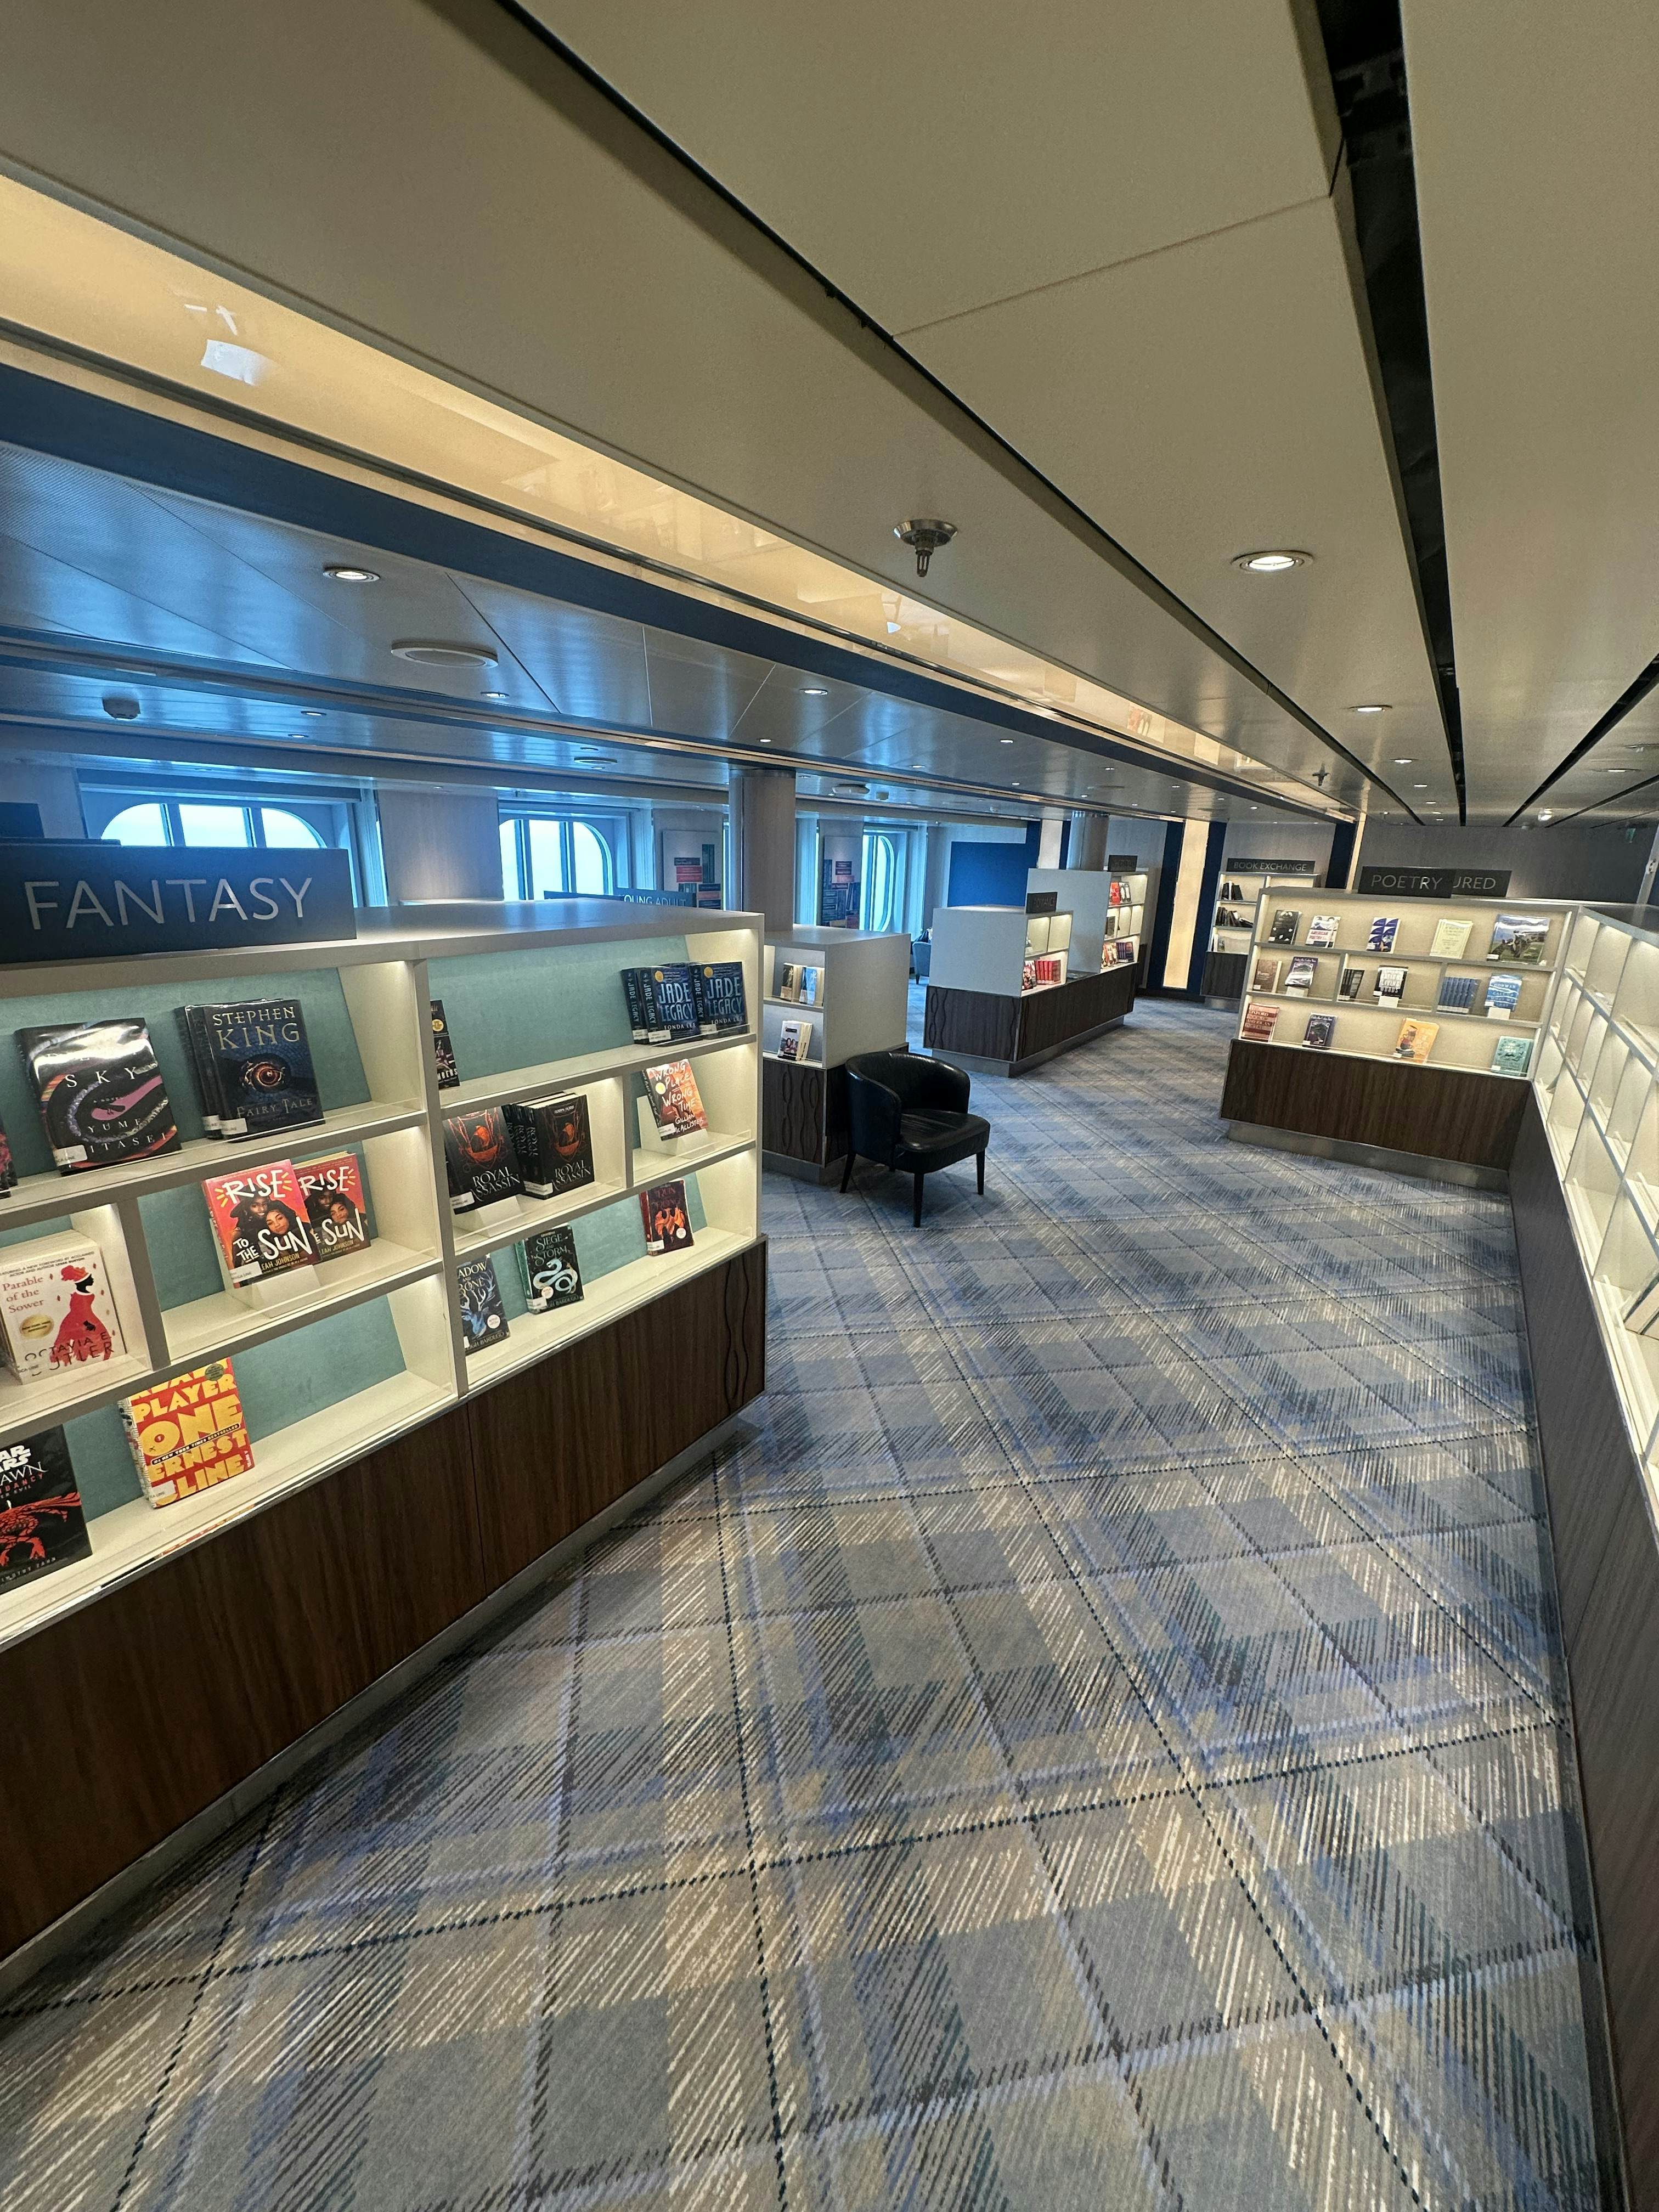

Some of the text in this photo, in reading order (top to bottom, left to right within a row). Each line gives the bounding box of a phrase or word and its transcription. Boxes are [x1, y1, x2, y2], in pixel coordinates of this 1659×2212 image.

[1260, 862, 1307, 871] EXCHANGE
[1371, 874, 1443, 890] POETRY
[1453, 876, 1496, 890] URED
[24, 877, 313, 930] FANTASY
[622, 894, 653, 905] OUNG
[628, 983, 636, 999] JADE
[644, 984, 653, 1001] JADE
[658, 982, 692, 1004] JADE
[707, 977, 741, 999] JADE
[212, 1006, 295, 1026] STEPHEN
[631, 1001, 640, 1022] LEGACY
[647, 1002, 657, 1024] LEGACY
[660, 1002, 693, 1022] LEGACY
[696, 997, 704, 1018] LEGACY
[708, 996, 742, 1017] LEGACY
[216, 1023, 300, 1051] KING
[65, 1066, 138, 1088] SKY
[651, 1062, 686, 1081] WRONG
[665, 1073, 692, 1090] PLACE
[662, 1088, 693, 1107] WRONG
[678, 1098, 698, 1112] TIME
[237, 1098, 313, 1119] FAIRY TALE
[88, 1118, 142, 1133] YUME
[89, 1132, 167, 1153] ITASEI
[472, 1166, 514, 1188] ROYAL
[555, 1159, 586, 1178] ROYAL
[222, 1169, 286, 1204] RISE
[299, 1166, 350, 1196] RISE
[233, 1237, 249, 1249] TO
[332, 1239, 354, 1252] JOHNSON
[536, 1233, 563, 1252] SIEGE
[236, 1245, 259, 1262] THE
[261, 1261, 274, 1271] EAH
[273, 1252, 300, 1267] JOHNSON
[534, 1245, 568, 1266] STORM
[458, 1261, 487, 1279] ADOW
[2, 1276, 44, 1291] Parable
[6, 1289, 40, 1303] of the
[8, 1299, 44, 1314] Sower
[25, 1337, 94, 1362] OCTAVIA
[32, 1342, 115, 1377] UTLER
[132, 1373, 238, 1424] PLAYER
[139, 1393, 243, 1457] ONE
[0, 1444, 31, 1463] AR
[146, 1428, 247, 1483] ERNEST
[0, 1461, 48, 1486] AWN
[0, 1472, 44, 1494] DANCY
[156, 1454, 245, 1506] LINE
[1, 1565, 32, 1583] IMOTHY
